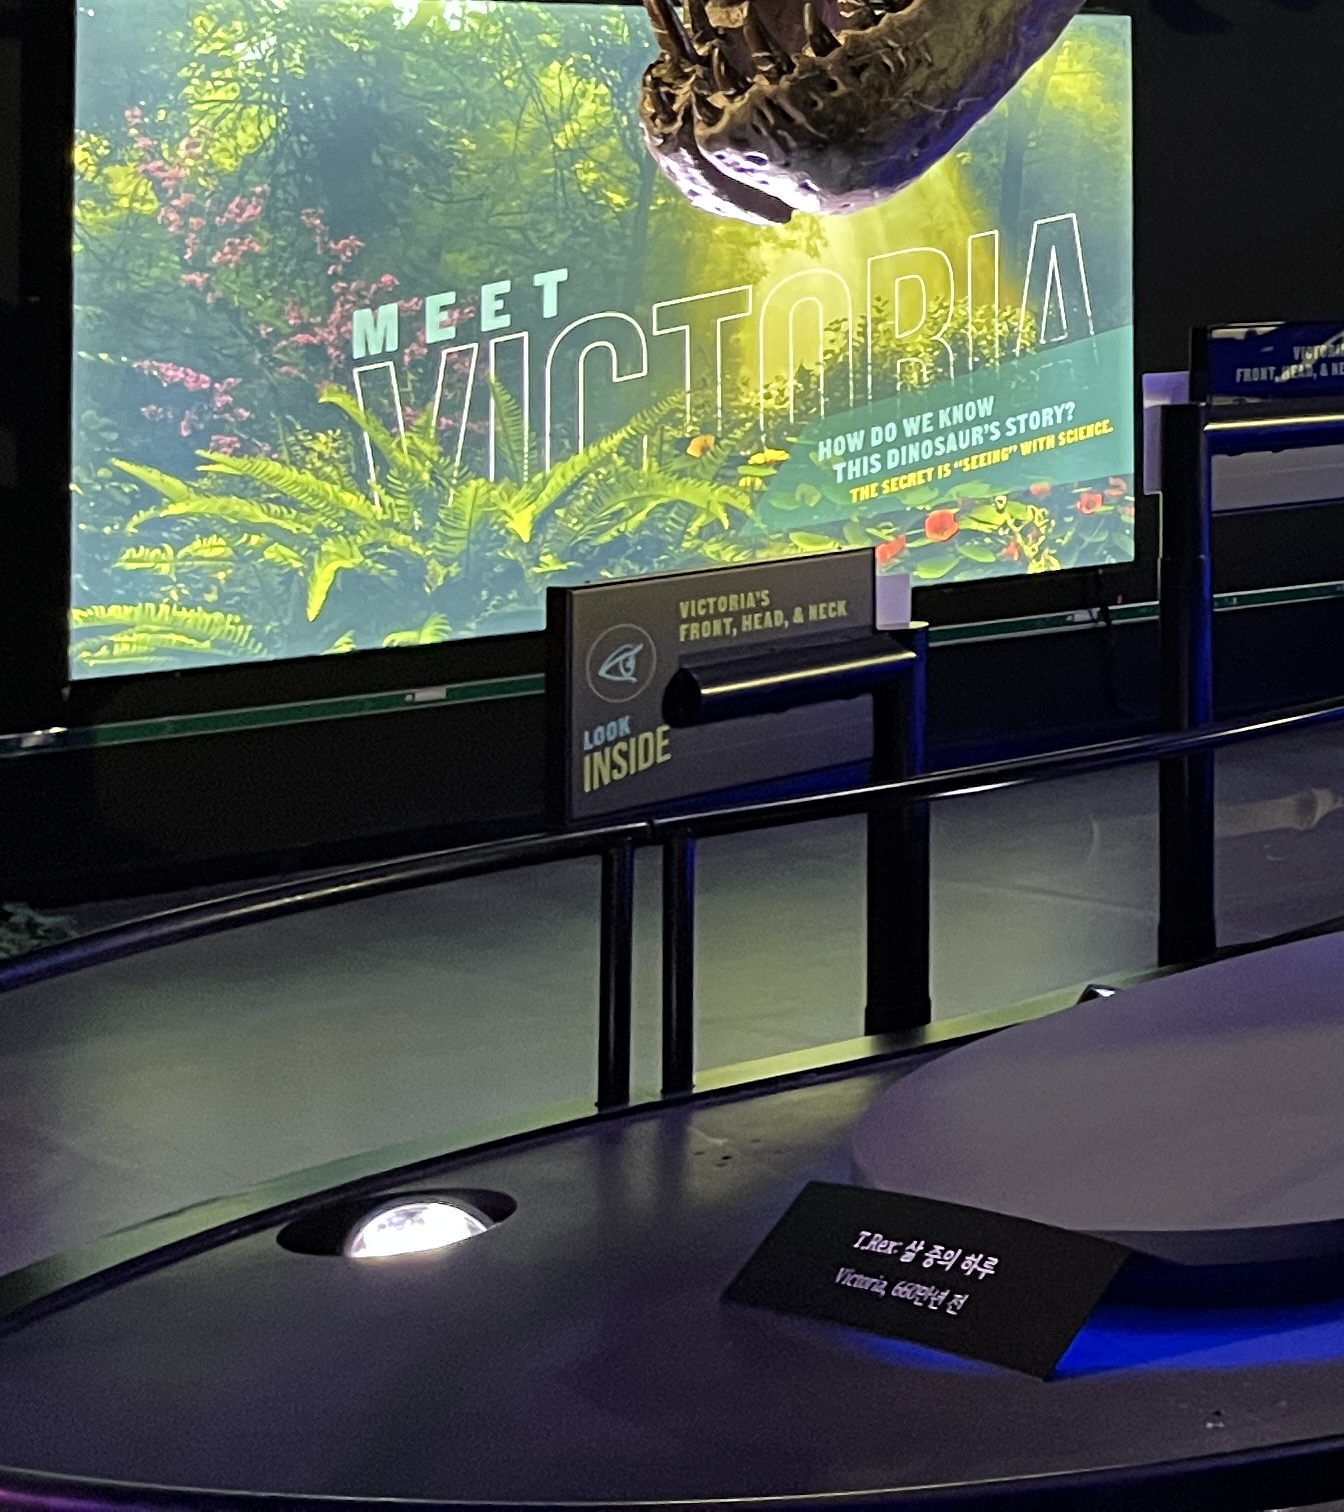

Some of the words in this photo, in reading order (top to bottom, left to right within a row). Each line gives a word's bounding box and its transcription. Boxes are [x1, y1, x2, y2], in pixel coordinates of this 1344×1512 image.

[353, 268, 568, 359] MEET
[353, 213, 1095, 506] VICTORIA
[1235, 366, 1279, 384] FRONT,
[1281, 363, 1318, 381] HEAD,
[1319, 363, 1329, 377] &
[817, 429, 865, 461] HOW
[871, 422, 898, 447] DO
[903, 412, 934, 438] WE
[938, 395, 995, 429] KNOW
[833, 453, 882, 483] THIS
[887, 421, 1001, 470] DINOSAUR'S
[1005, 401, 1076, 437] STORY?
[849, 483, 879, 503] THE
[882, 468, 934, 494] SECRET
[937, 464, 951, 479] IS
[954, 444, 1017, 472] "SEEING"
[1020, 438, 1055, 456] WITH
[1057, 419, 1114, 446] SCIENCE.
[679, 590, 771, 619] VICTORIA'S
[679, 617, 738, 642] FRONT,
[741, 608, 789, 636] HEAD,
[793, 607, 804, 623] &
[808, 600, 847, 620] NECK
[583, 716, 631, 751] LOOK
[583, 724, 672, 792] INSIDE
[921, 1244, 963, 1272] 중의
[960, 1253, 1000, 1280] 하루
[946, 1294, 970, 1316] 전
